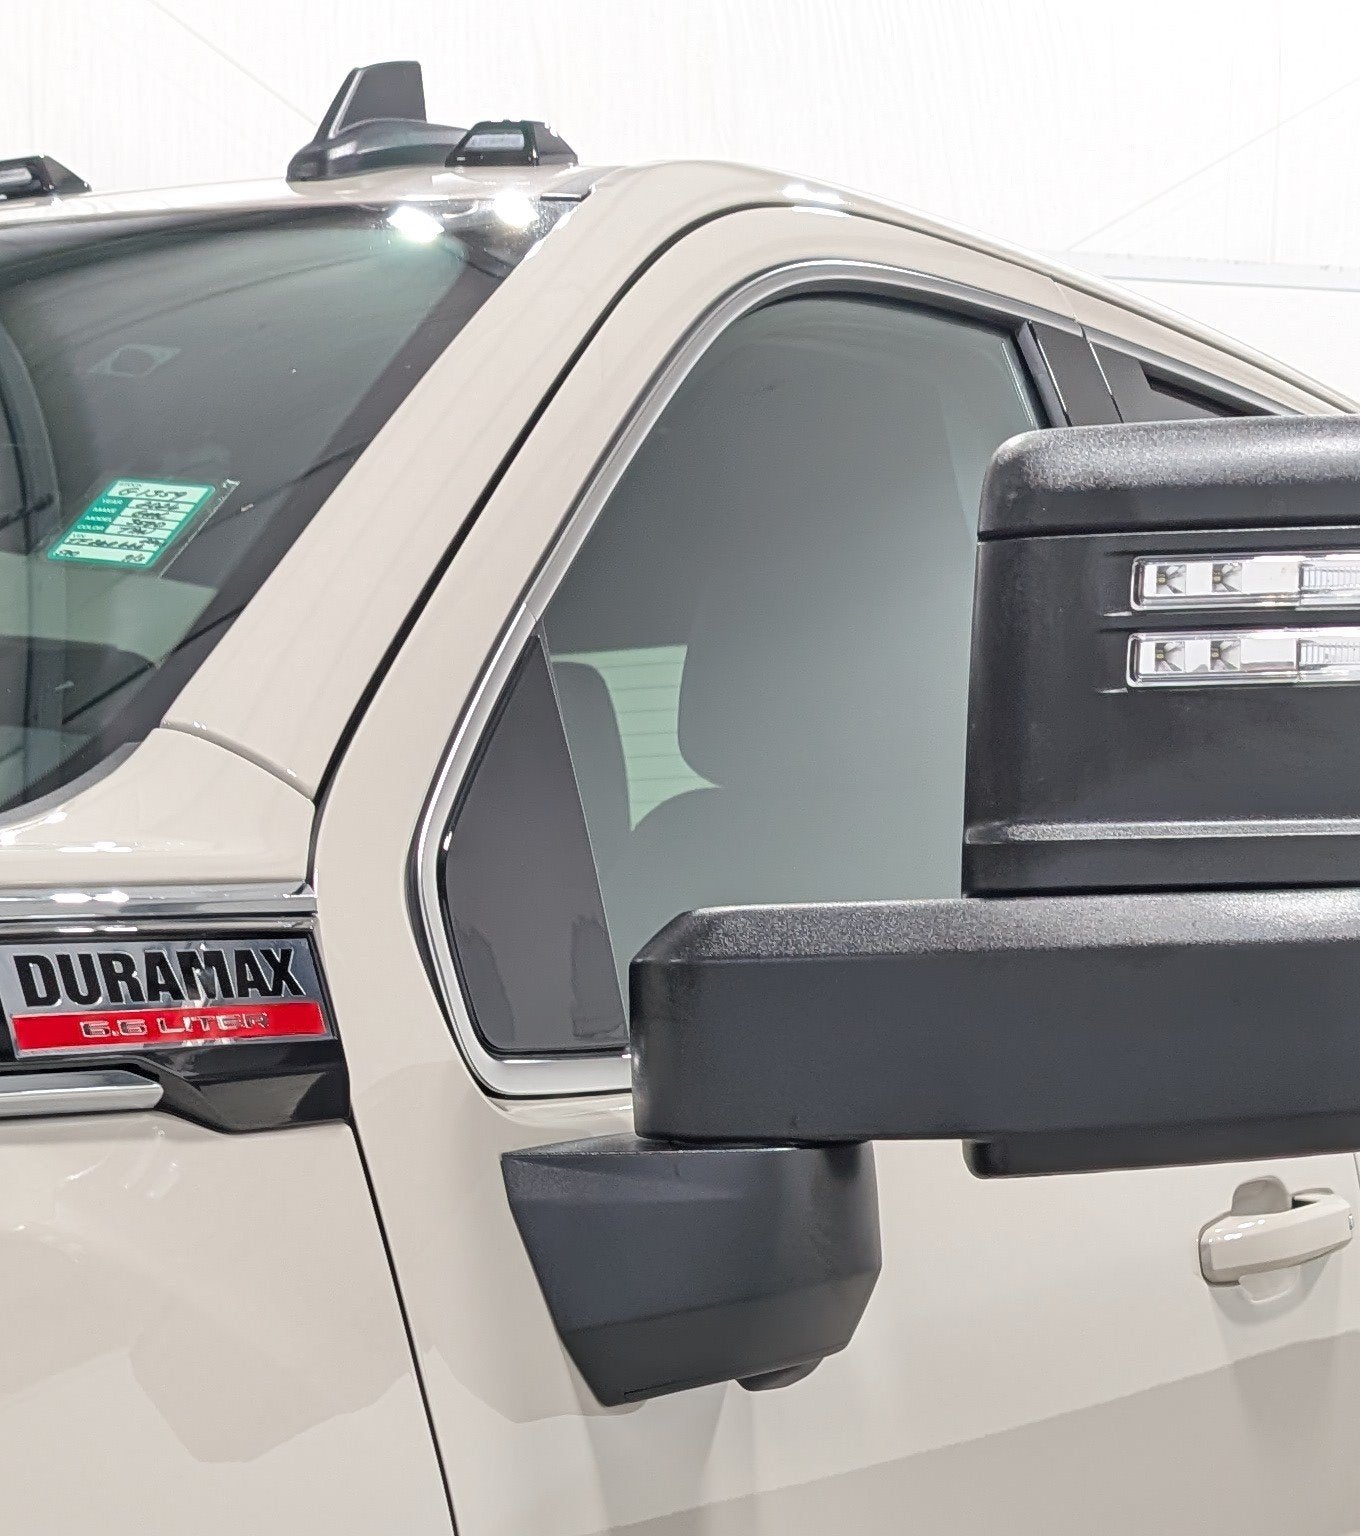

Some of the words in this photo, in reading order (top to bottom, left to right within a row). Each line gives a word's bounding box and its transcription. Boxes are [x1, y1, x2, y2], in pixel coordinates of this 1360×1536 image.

[13, 948, 307, 1008] DURAMAX
[80, 1018, 148, 1039] 6.6
[156, 1010, 270, 1034] LITER
